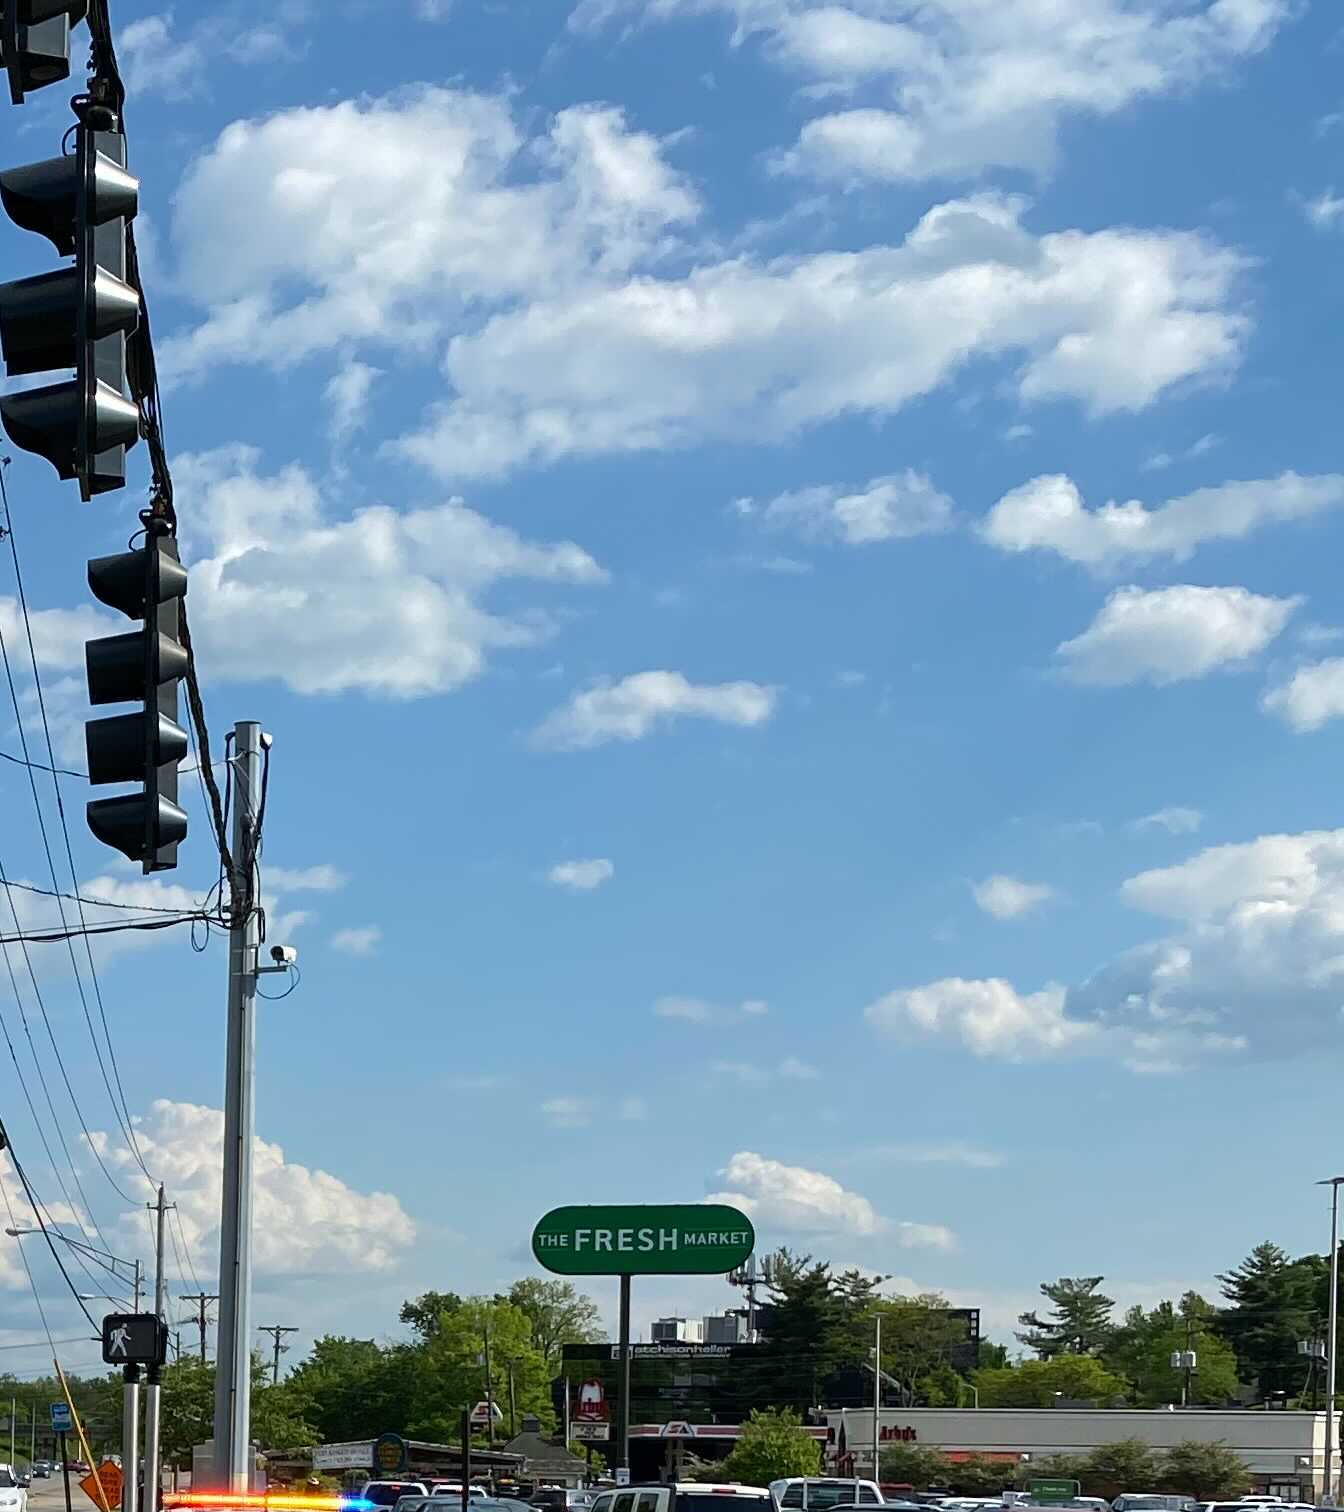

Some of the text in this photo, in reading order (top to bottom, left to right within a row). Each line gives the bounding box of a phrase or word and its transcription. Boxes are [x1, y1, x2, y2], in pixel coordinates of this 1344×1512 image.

[538, 1228, 749, 1252] THE FRESH MARKET
